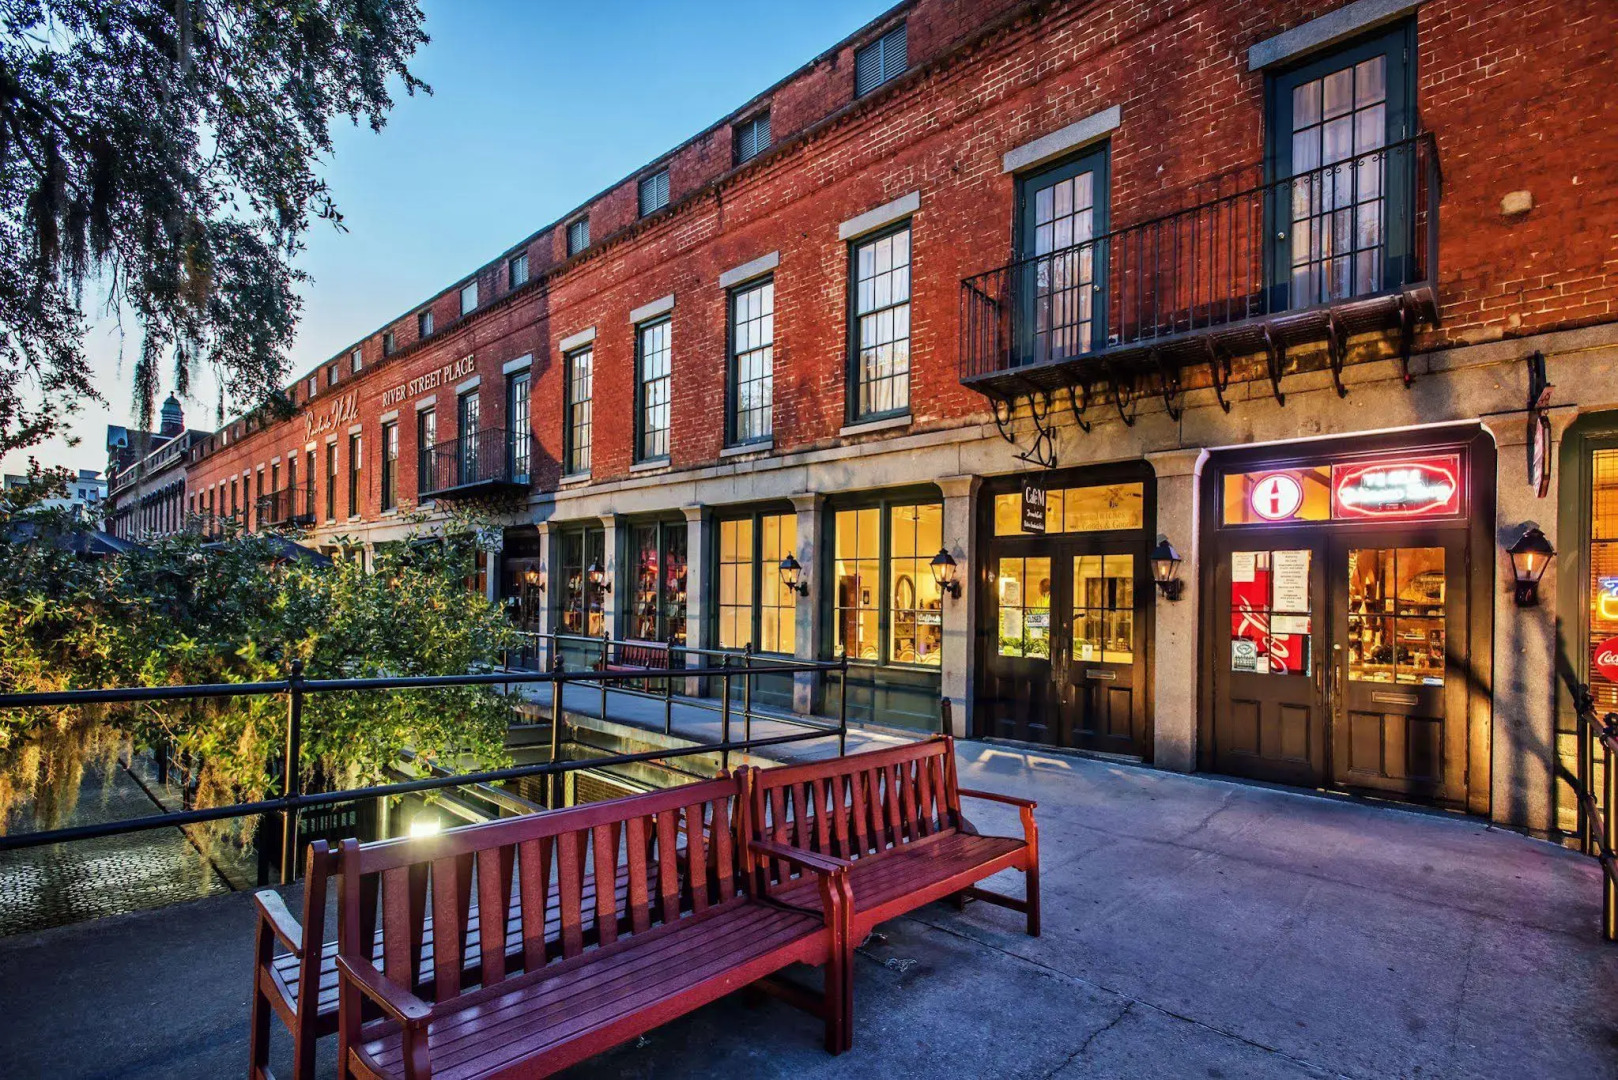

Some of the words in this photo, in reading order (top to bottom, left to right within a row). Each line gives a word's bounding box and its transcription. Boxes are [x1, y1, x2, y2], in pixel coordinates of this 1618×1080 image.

[382, 384, 406, 407] RIVER
[409, 369, 442, 396] STREET
[443, 354, 475, 383] PLACE
[331, 389, 359, 430] Walk
